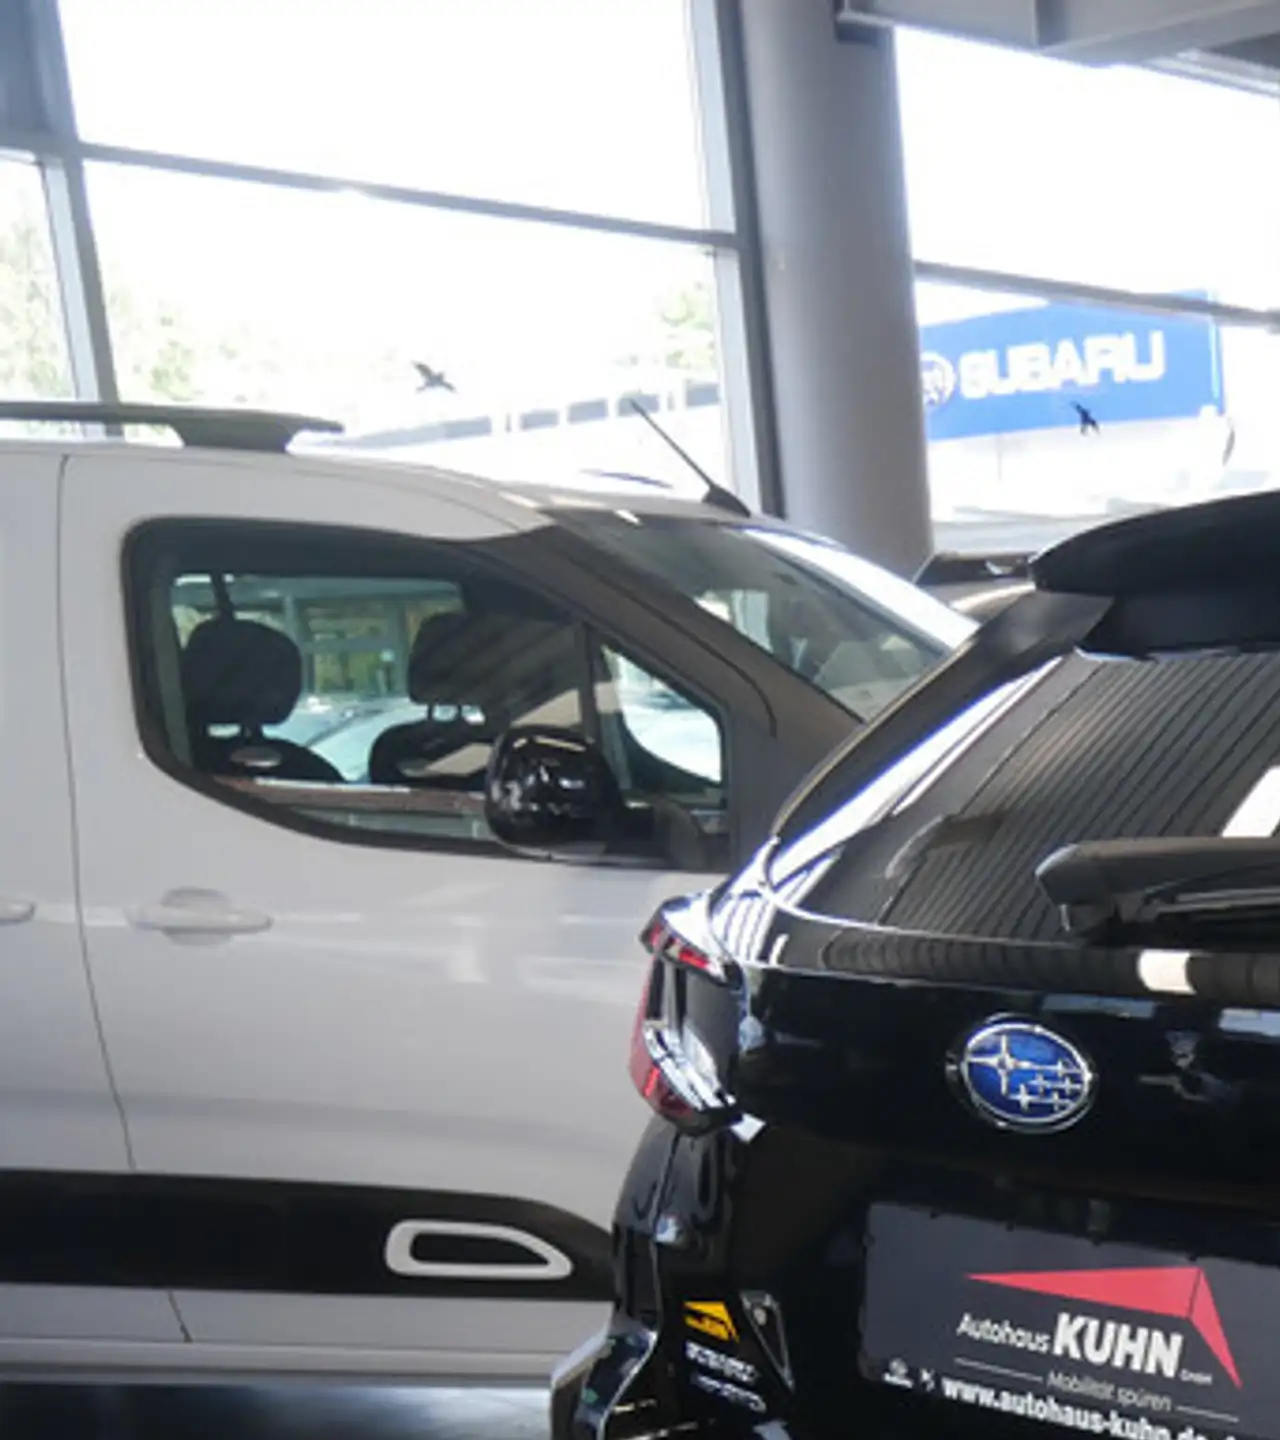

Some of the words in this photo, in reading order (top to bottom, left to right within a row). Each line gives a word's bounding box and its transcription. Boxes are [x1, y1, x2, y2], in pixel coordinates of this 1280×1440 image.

[958, 330, 1166, 399] SUBARU
[957, 1313, 1050, 1353] Autohaus
[1053, 1312, 1183, 1378] KUHN
[1117, 1384, 1172, 1412] spüren
